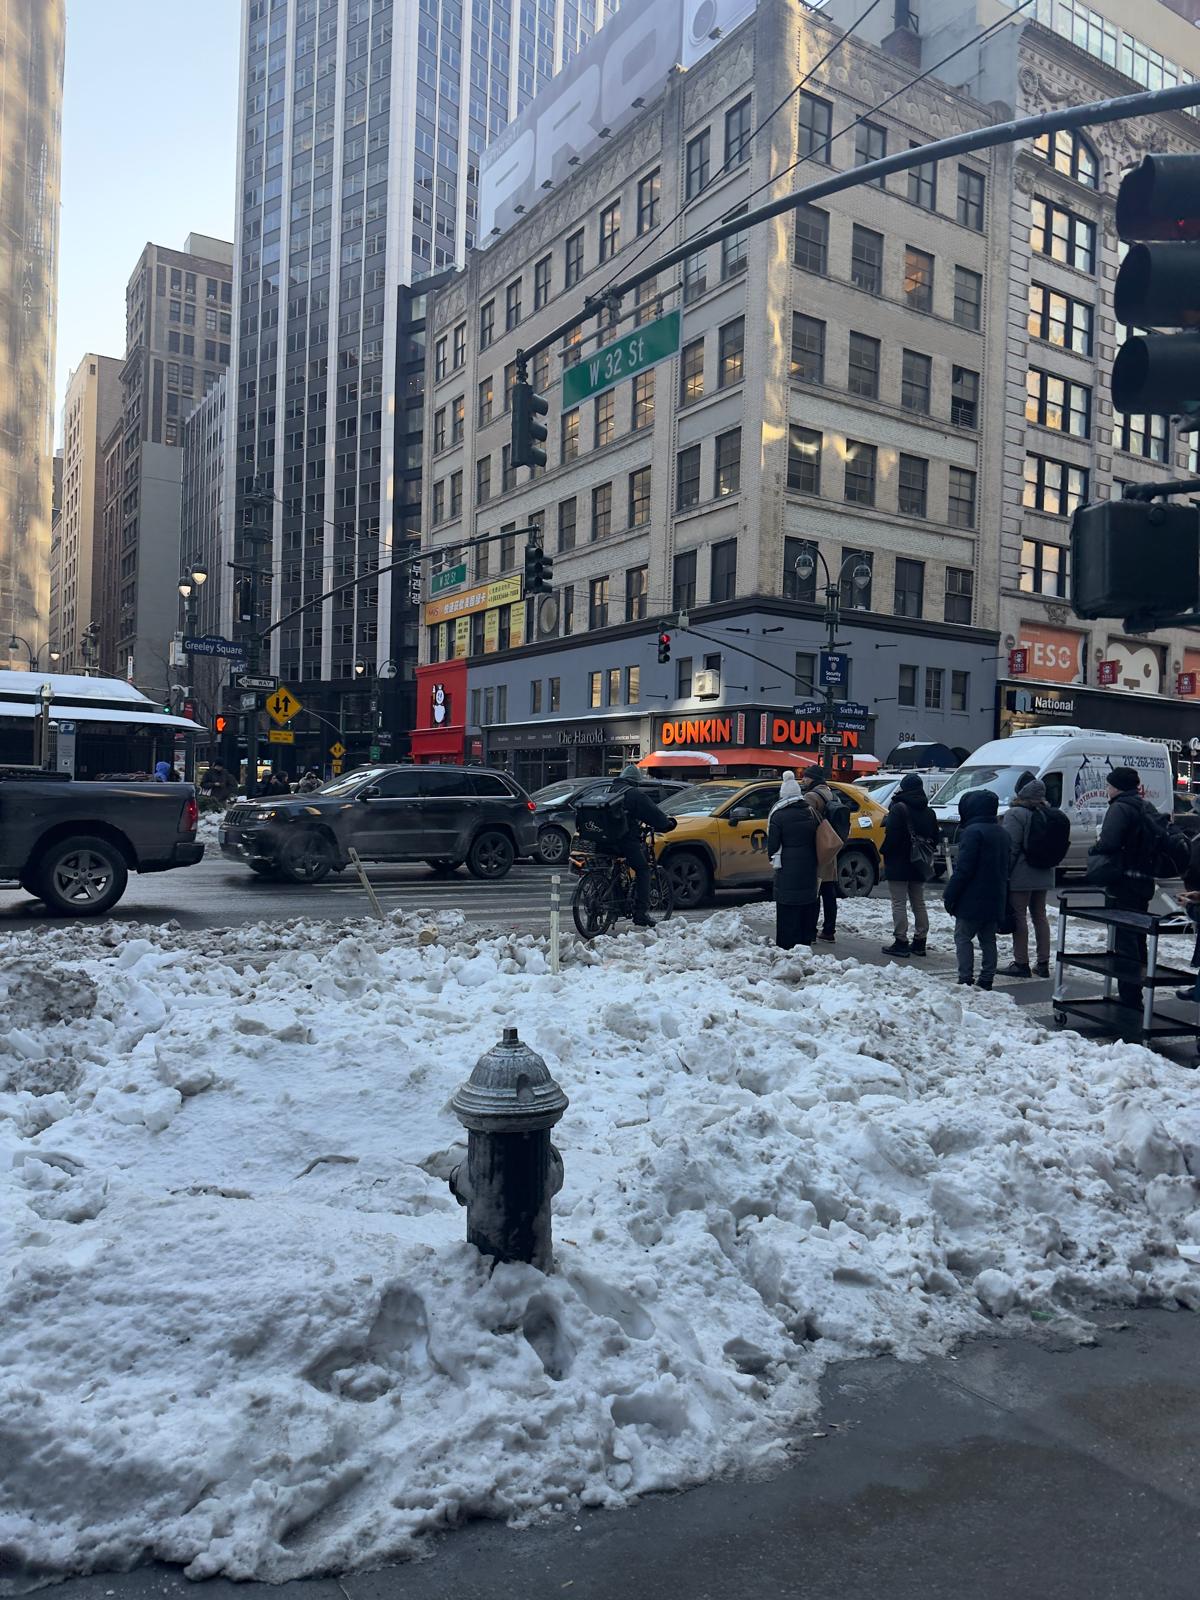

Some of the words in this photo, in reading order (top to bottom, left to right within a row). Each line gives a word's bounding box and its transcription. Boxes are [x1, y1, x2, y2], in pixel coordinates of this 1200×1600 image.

[589, 357, 602, 388] W
[604, 351, 622, 378] 32
[627, 338, 645, 369] St
[184, 640, 215, 654] Greeley
[216, 644, 242, 654] Square
[1035, 696, 1074, 710] National
[557, 729, 572, 744] The
[772, 719, 858, 748] DUNN
[899, 732, 916, 742] 894
